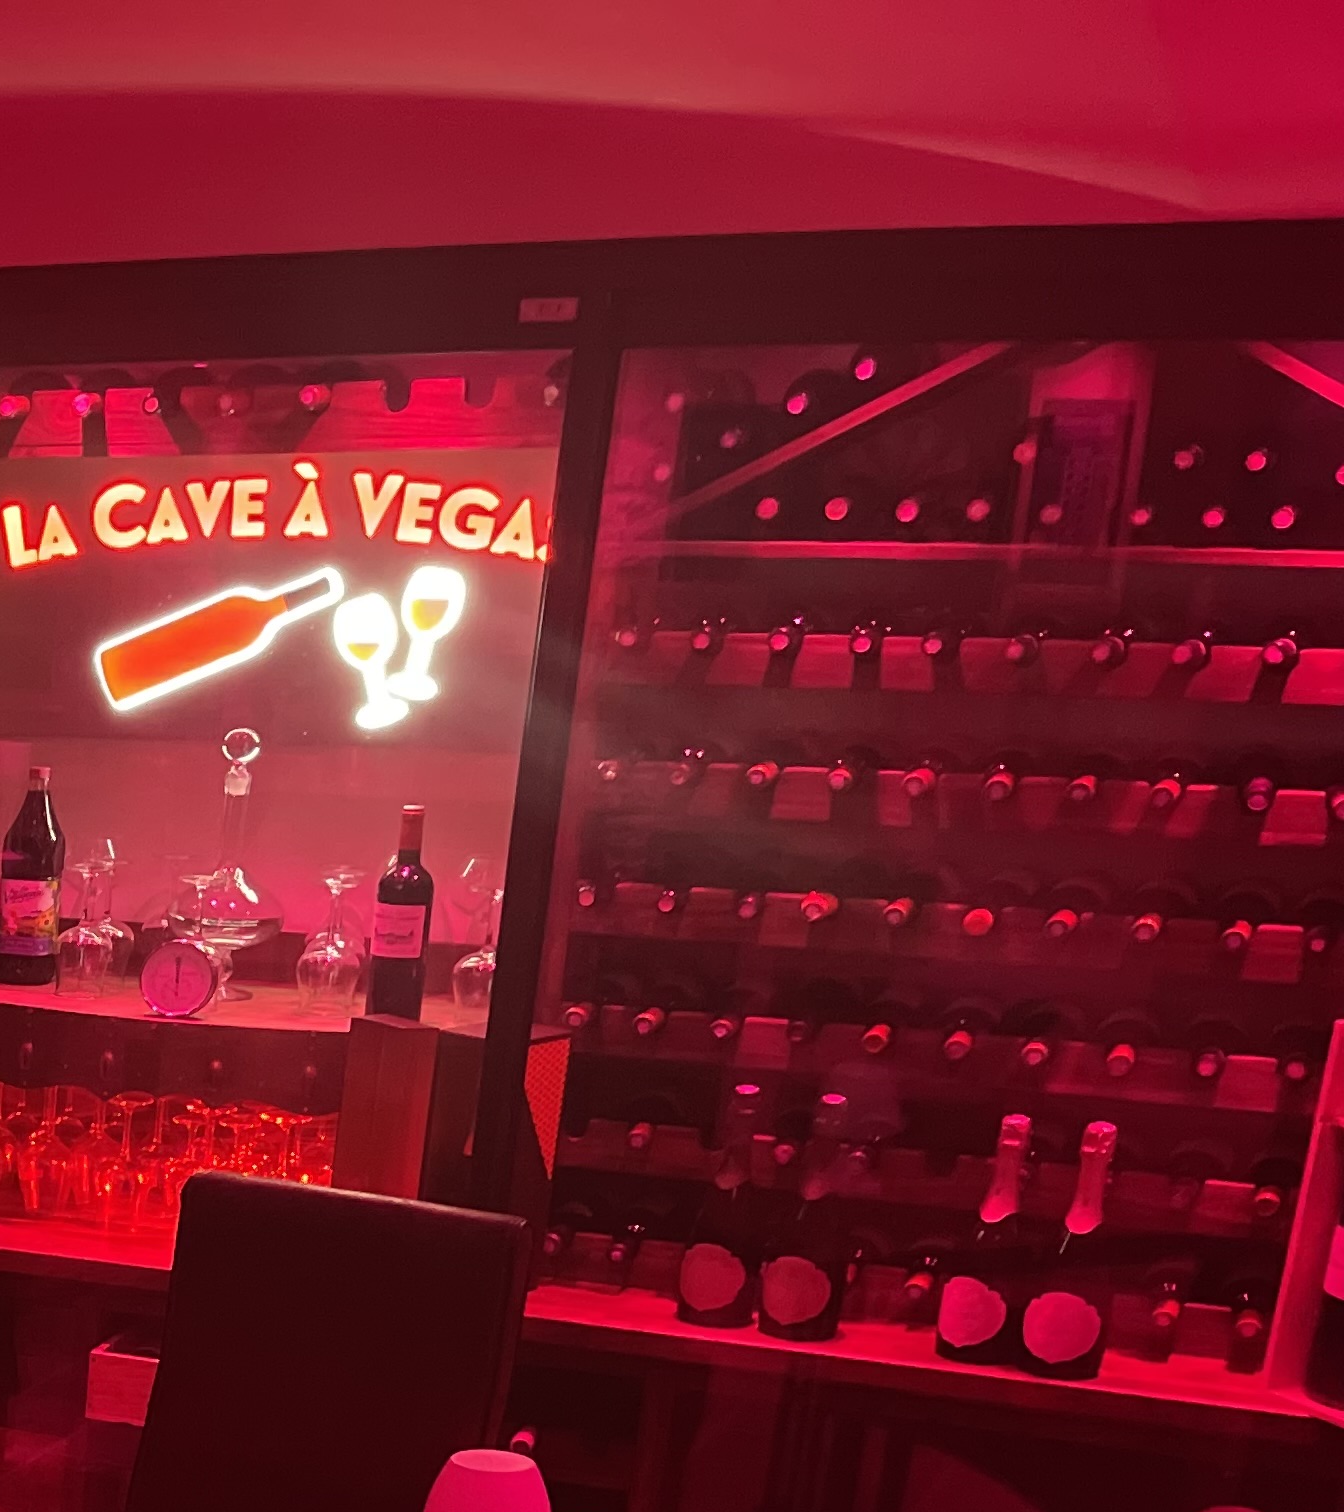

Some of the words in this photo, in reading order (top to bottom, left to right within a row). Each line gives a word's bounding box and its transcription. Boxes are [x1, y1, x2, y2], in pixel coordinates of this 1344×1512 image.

[0, 502, 80, 570] LA
[91, 476, 270, 549] CAVE
[283, 460, 332, 539] À
[351, 470, 553, 562] VEGA
